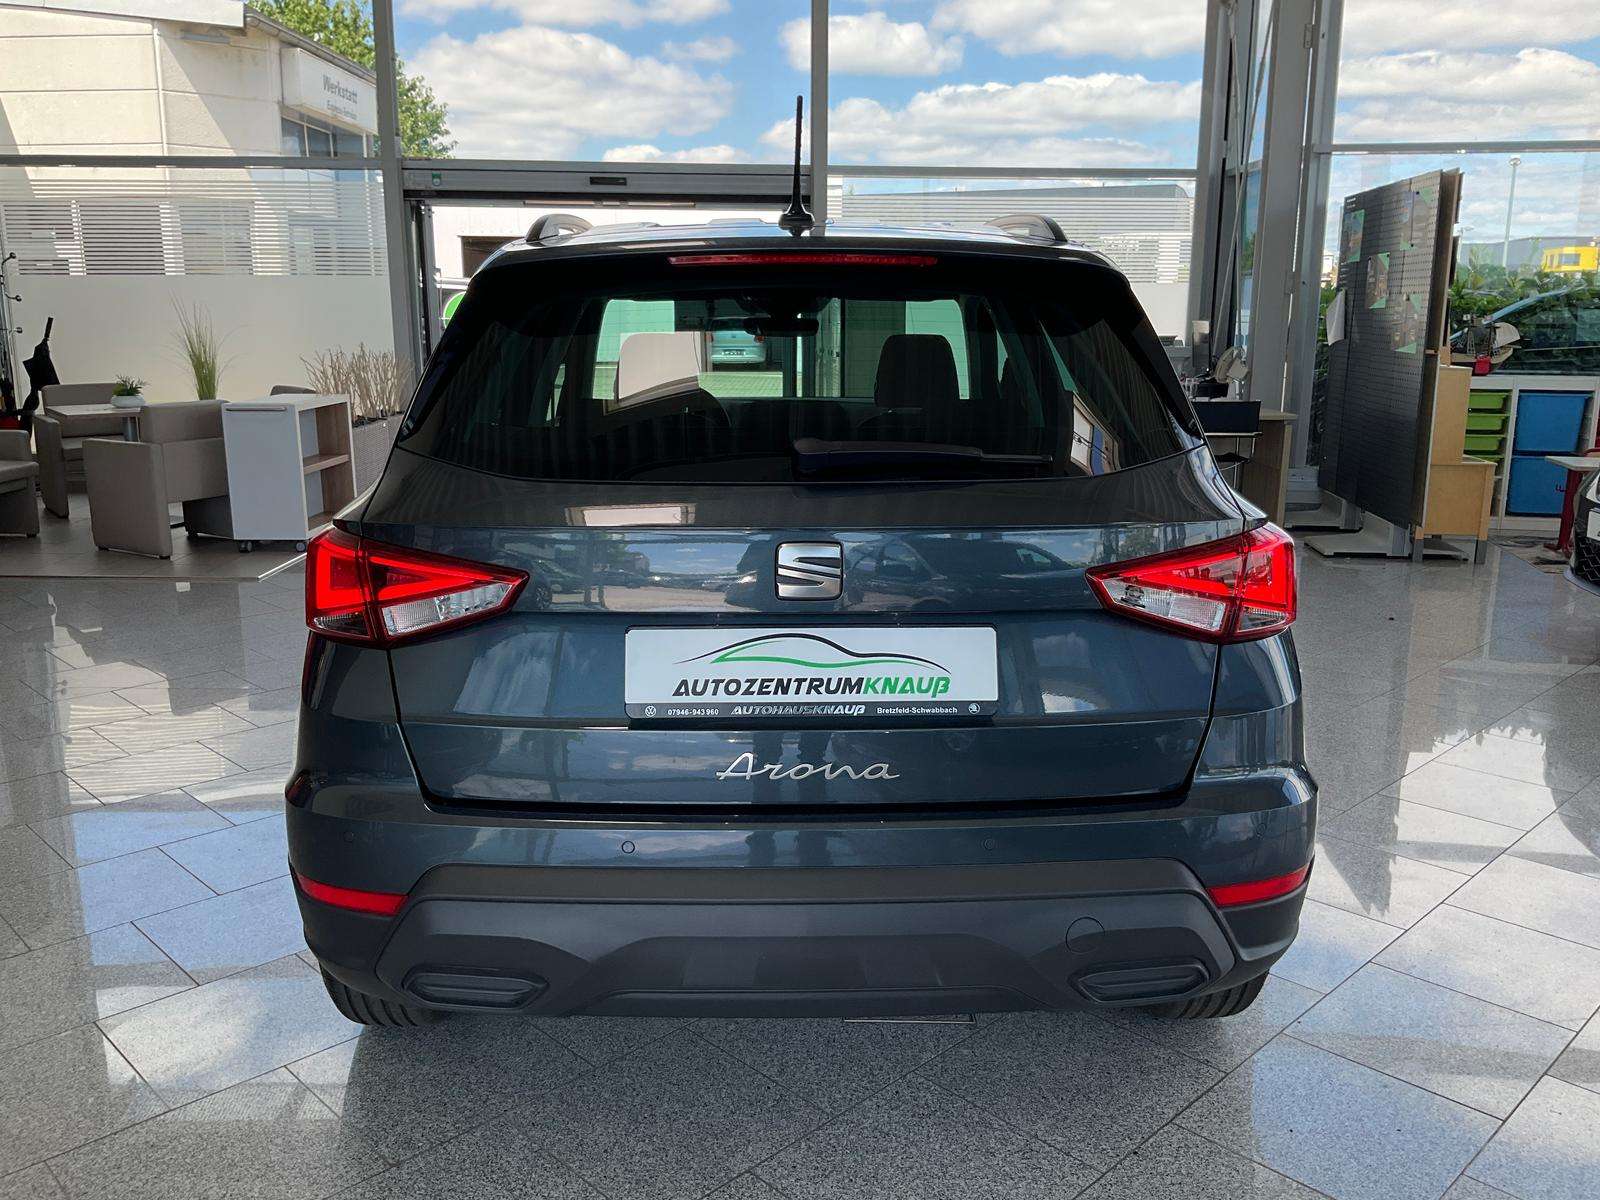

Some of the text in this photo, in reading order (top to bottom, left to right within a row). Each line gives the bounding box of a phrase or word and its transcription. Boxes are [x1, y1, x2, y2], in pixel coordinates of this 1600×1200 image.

[322, 74, 358, 105] Werkstatt
[877, 706, 958, 714] Bretzfeld-Schwabbach
[716, 752, 900, 780] Arona
